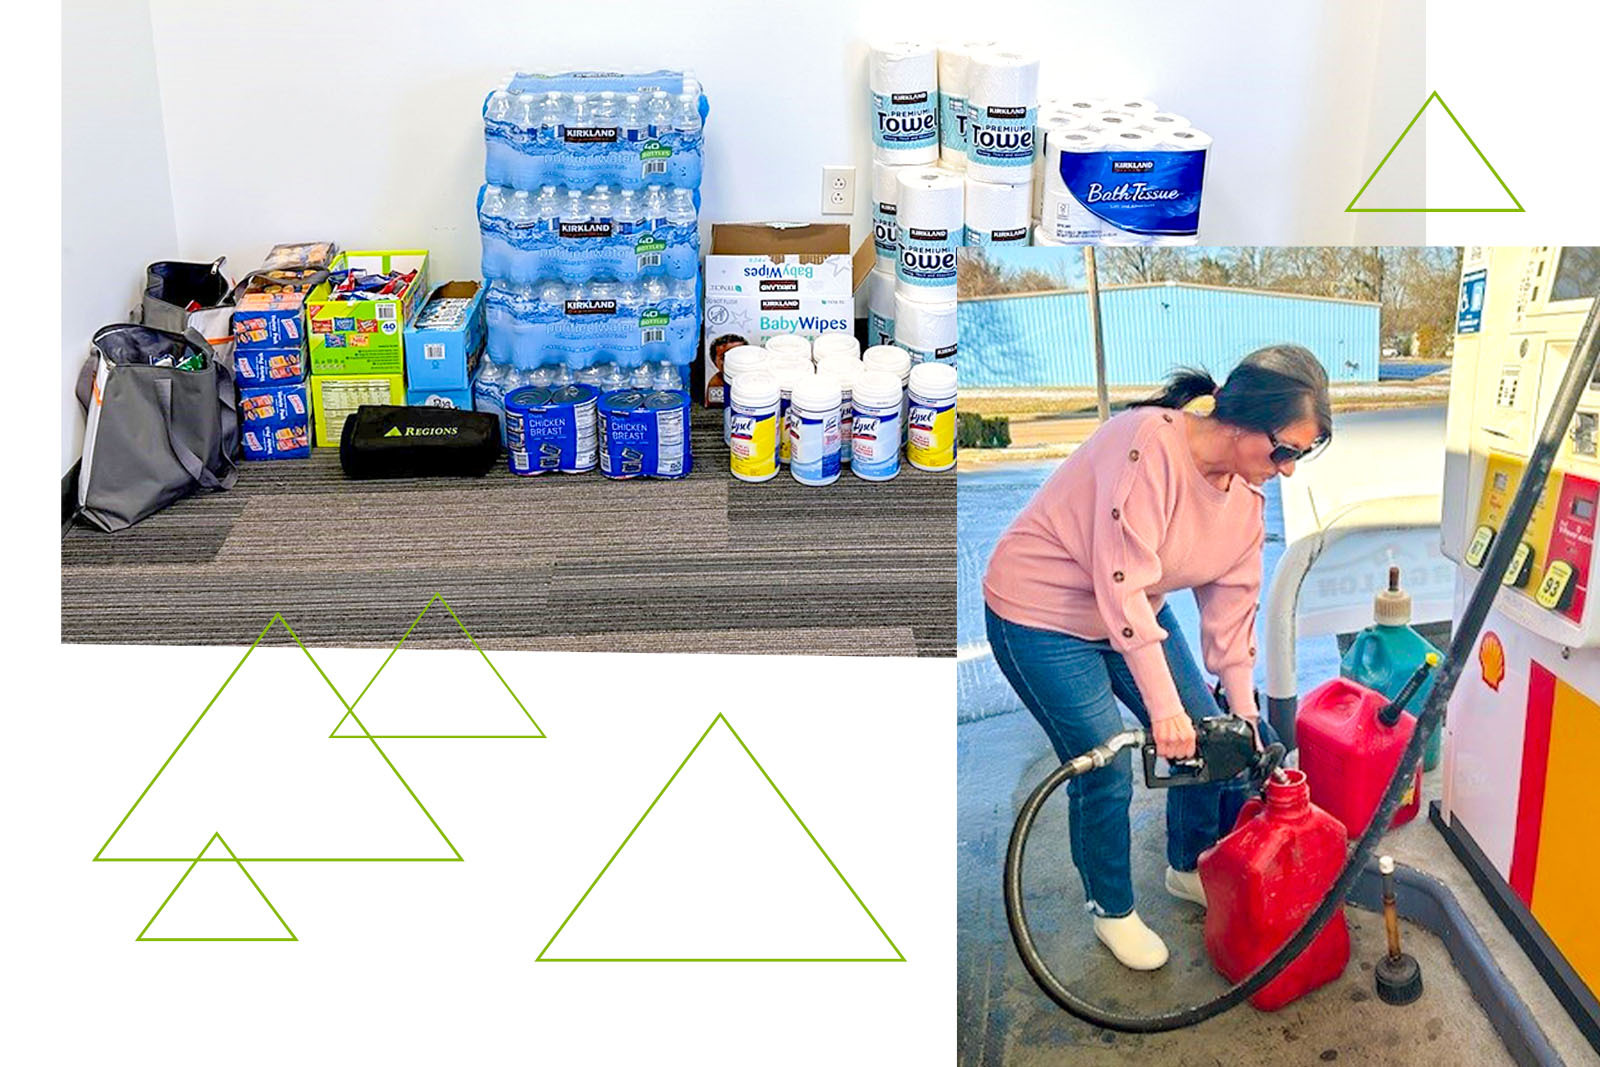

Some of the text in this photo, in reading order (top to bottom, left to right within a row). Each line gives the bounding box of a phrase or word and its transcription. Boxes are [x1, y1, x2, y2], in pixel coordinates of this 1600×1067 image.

[890, 109, 928, 117] PREMIUM
[877, 107, 938, 132] Towel
[566, 129, 616, 138] KIRKLAND
[985, 124, 1026, 133] PREMIUM
[971, 124, 1035, 149] Towel
[1113, 161, 1154, 169] KIRKLAND
[1087, 182, 1179, 203] Bath Tissue
[561, 224, 611, 233] KIRKLAND
[908, 245, 949, 254] PREMIUM
[566, 301, 616, 310] KIRKLAND
[529, 418, 566, 428] CHICKEN
[611, 422, 648, 432] CHICKEN
[404, 426, 459, 437] REGIONS
[530, 427, 563, 437] BREAST
[612, 431, 644, 441] BREAST
[1543, 577, 1560, 597] 93
